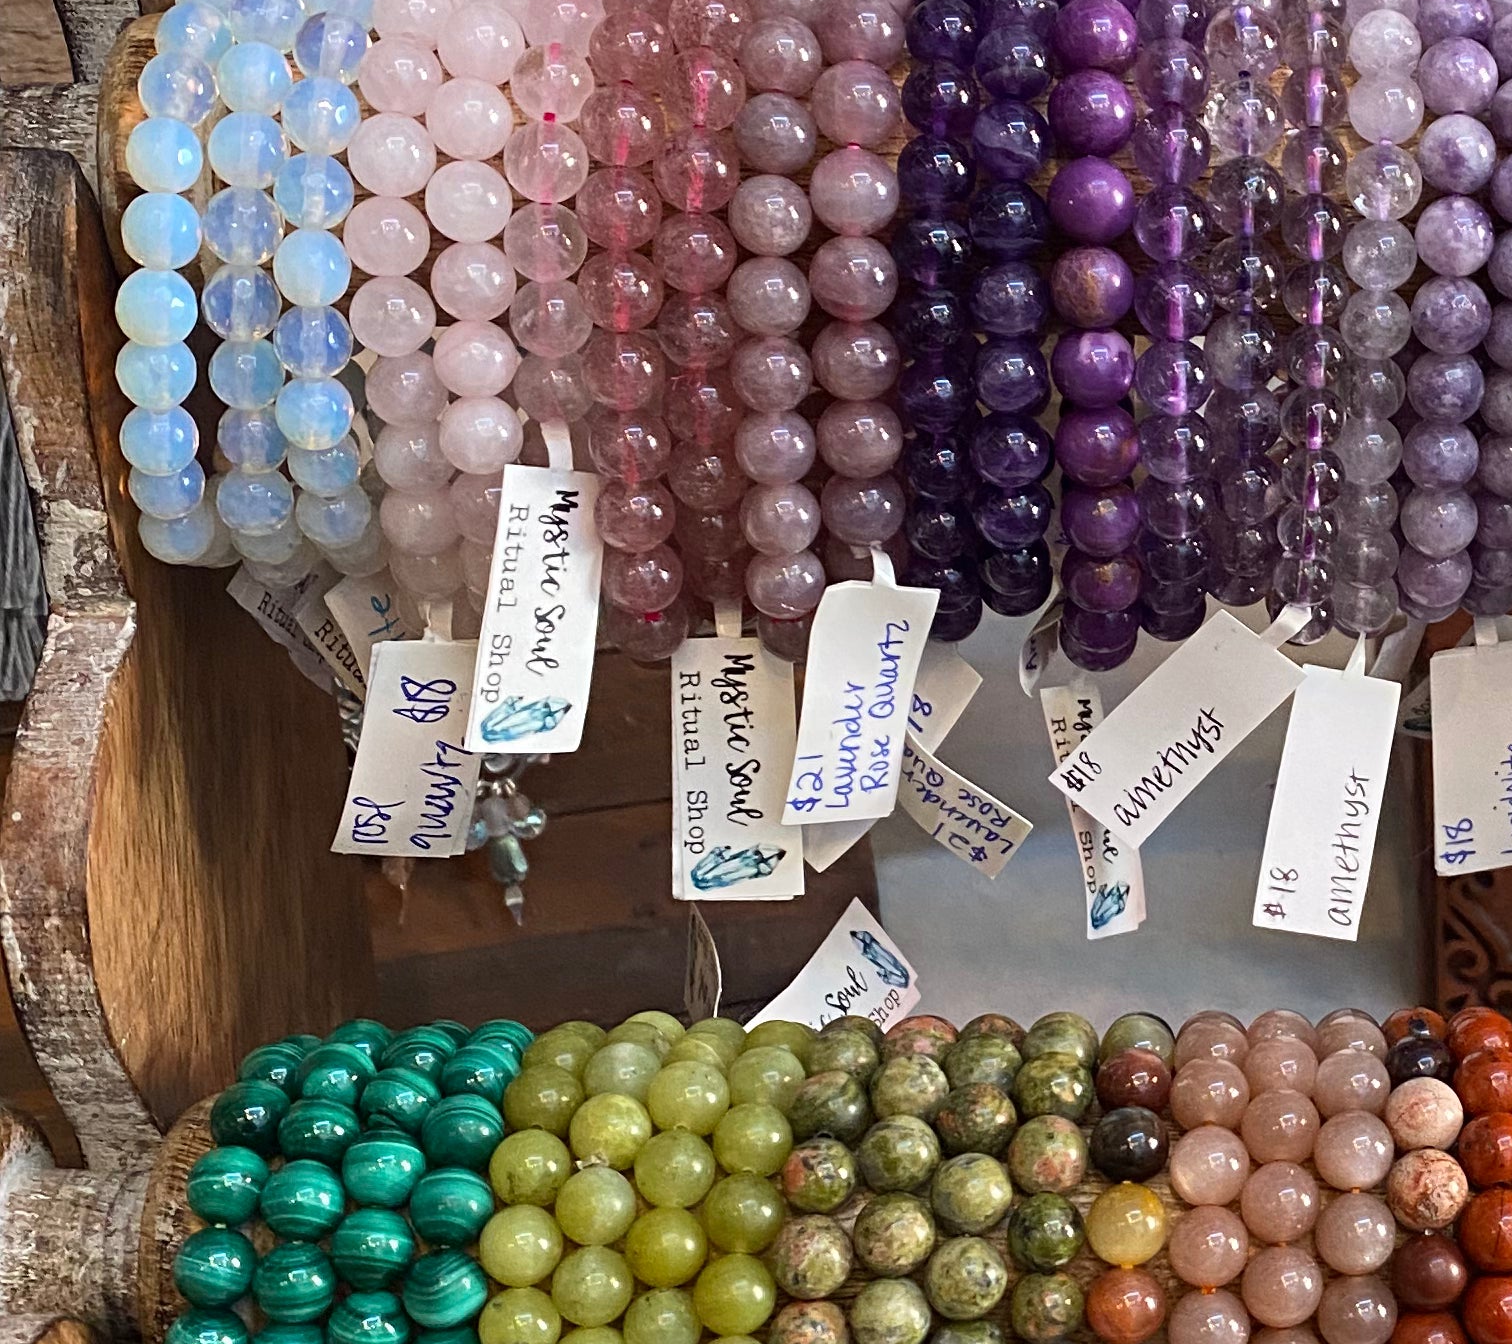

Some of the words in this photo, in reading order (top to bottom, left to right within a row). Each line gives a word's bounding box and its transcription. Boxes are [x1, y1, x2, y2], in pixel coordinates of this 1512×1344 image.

[496, 504, 530, 613] Ritual
[538, 490, 580, 597] Mystic
[314, 618, 366, 690] Ritua
[481, 634, 512, 703] Shop
[525, 604, 567, 676] Soul
[393, 675, 457, 723] $18
[680, 671, 706, 770] Ritual
[711, 654, 755, 753] Mystic
[725, 759, 764, 827] Soul
[786, 754, 824, 812] $21
[860, 735, 890, 792] Rose
[903, 742, 944, 787] Qua
[1060, 751, 1102, 792] $18
[1113, 706, 1225, 827] amethyst
[684, 790, 708, 854] Shop
[932, 823, 988, 862] $21
[1328, 766, 1370, 926] amethyst
[1440, 817, 1476, 865] $18
[1079, 830, 1097, 894] Shop
[825, 965, 869, 1016] Soul
